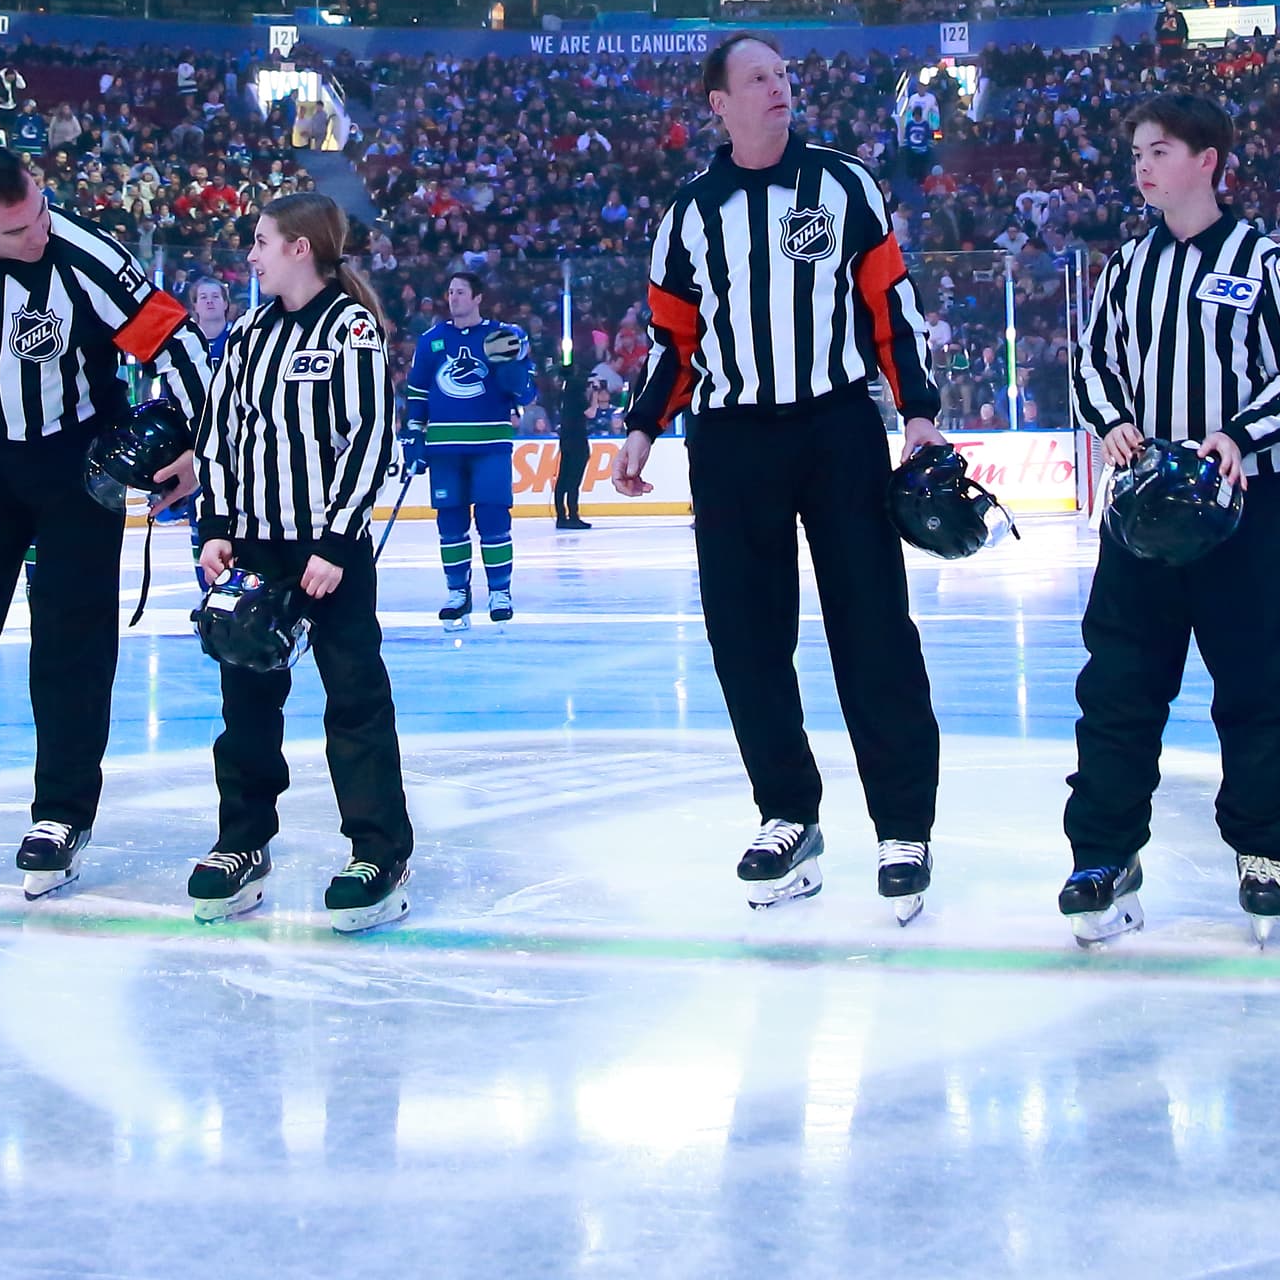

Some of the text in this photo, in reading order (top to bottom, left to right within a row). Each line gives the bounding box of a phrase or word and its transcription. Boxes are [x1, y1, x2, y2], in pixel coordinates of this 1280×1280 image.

[275, 31, 295, 46] 121
[530, 33, 707, 54] WE ARE ALL CANUCKS
[943, 26, 966, 42] 122
[793, 221, 824, 251] NHL
[118, 264, 143, 293] 37
[1207, 279, 1252, 300] BC
[21, 322, 51, 352] NHL
[293, 356, 330, 373] BC
[512, 442, 619, 494] SKP
